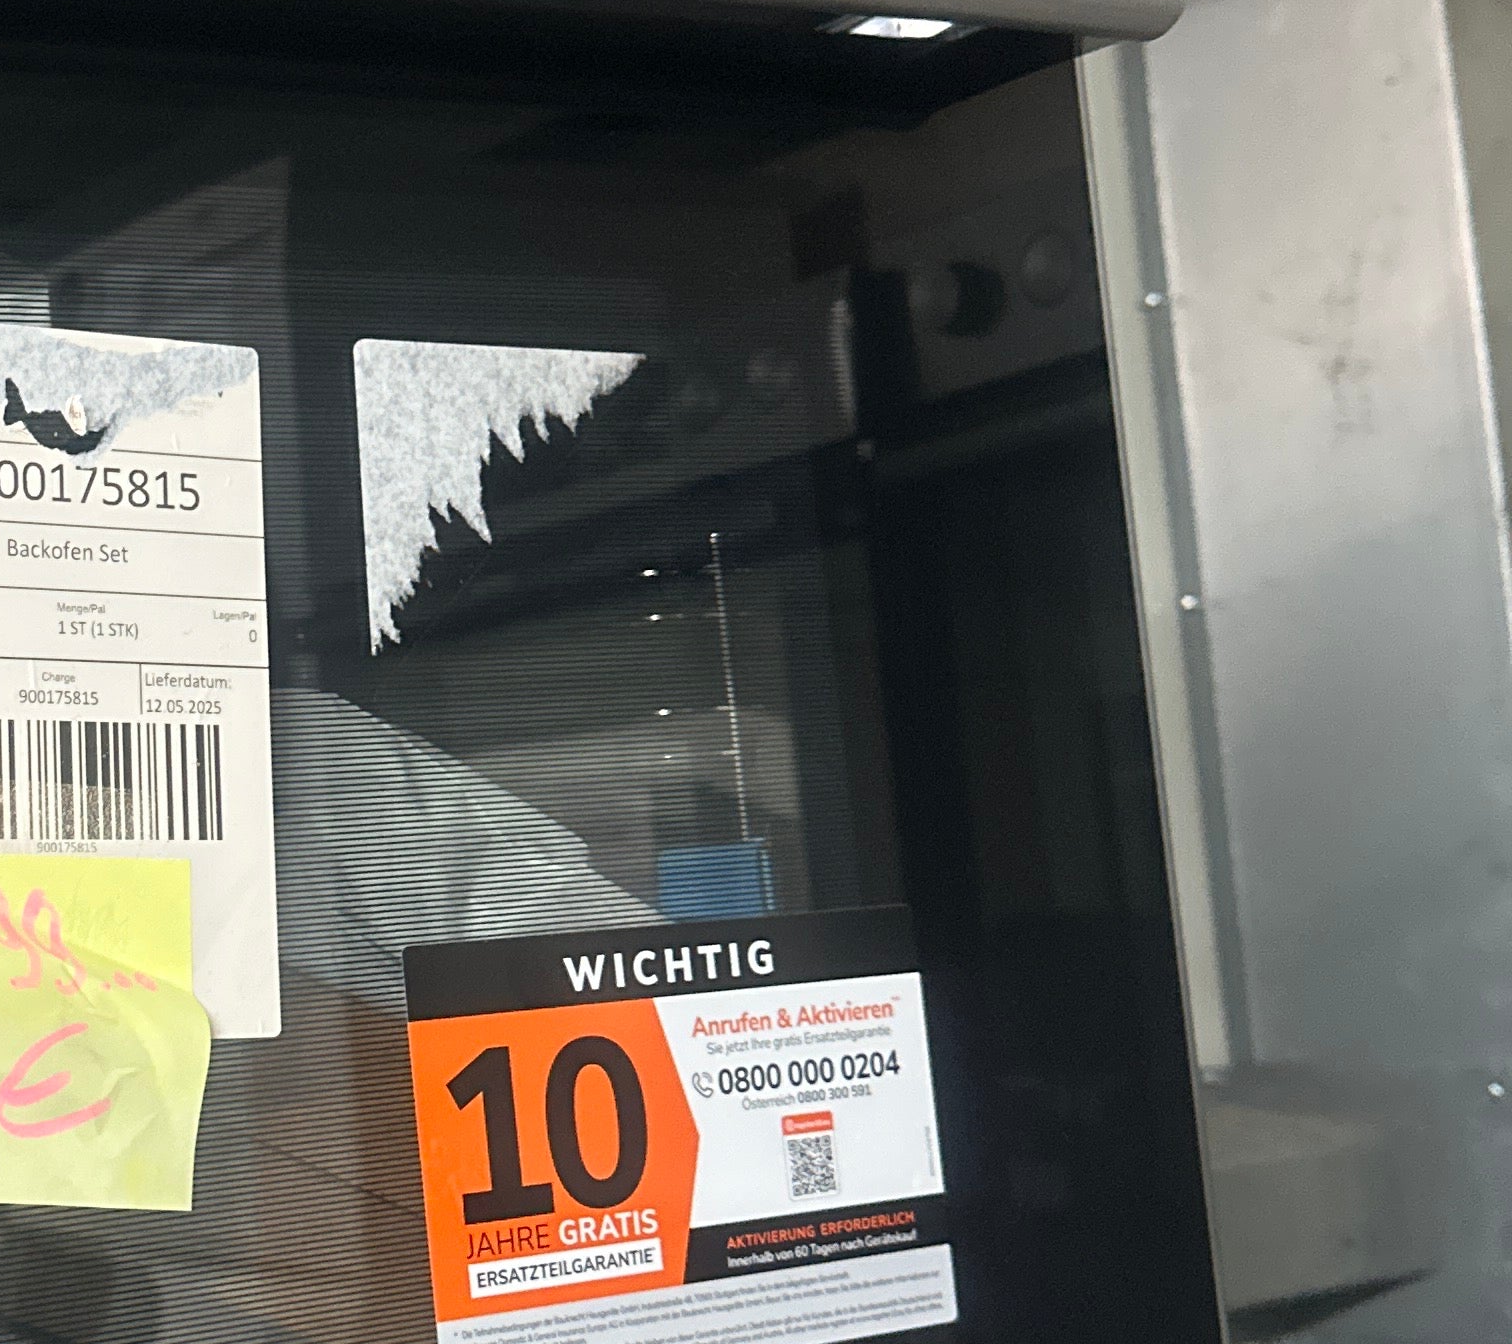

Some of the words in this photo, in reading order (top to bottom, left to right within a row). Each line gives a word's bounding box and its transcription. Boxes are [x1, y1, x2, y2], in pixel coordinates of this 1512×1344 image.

[7, 538, 94, 562] Backofen
[100, 543, 129, 563] Set
[58, 620, 66, 635] 1
[70, 620, 87, 636] ST
[91, 621, 105, 639] (1
[107, 623, 139, 640] STK)
[248, 629, 258, 644] 0
[41, 671, 76, 684] Charge
[145, 672, 232, 690] Lieferdatum:
[18, 689, 99, 706] 900175815
[146, 697, 222, 715] 12.05.2025
[37, 841, 98, 854] 900175815
[563, 939, 775, 992] WICHTIG
[692, 1012, 772, 1038] Anrufen
[777, 1009, 792, 1028] &
[706, 1041, 723, 1054] Sie
[726, 1040, 750, 1056] jetzt
[773, 1035, 802, 1050] gratis
[718, 1063, 781, 1095] 0800
[788, 1057, 835, 1087] 000
[841, 1050, 900, 1080] 0204
[797, 1089, 826, 1103] 0800
[829, 1086, 849, 1099] 300
[851, 1084, 872, 1097] 591
[446, 1036, 648, 1225] 10
[467, 1224, 550, 1259] JAHRE
[558, 1208, 659, 1246] GRATIS
[727, 1225, 816, 1249] AKTIVIERUNG
[820, 1211, 915, 1236] ERFORDERLICH
[727, 1251, 774, 1268] Innerhalb
[795, 1245, 809, 1257] 60
[810, 1242, 840, 1257] Tagen
[840, 1237, 865, 1251] nach
